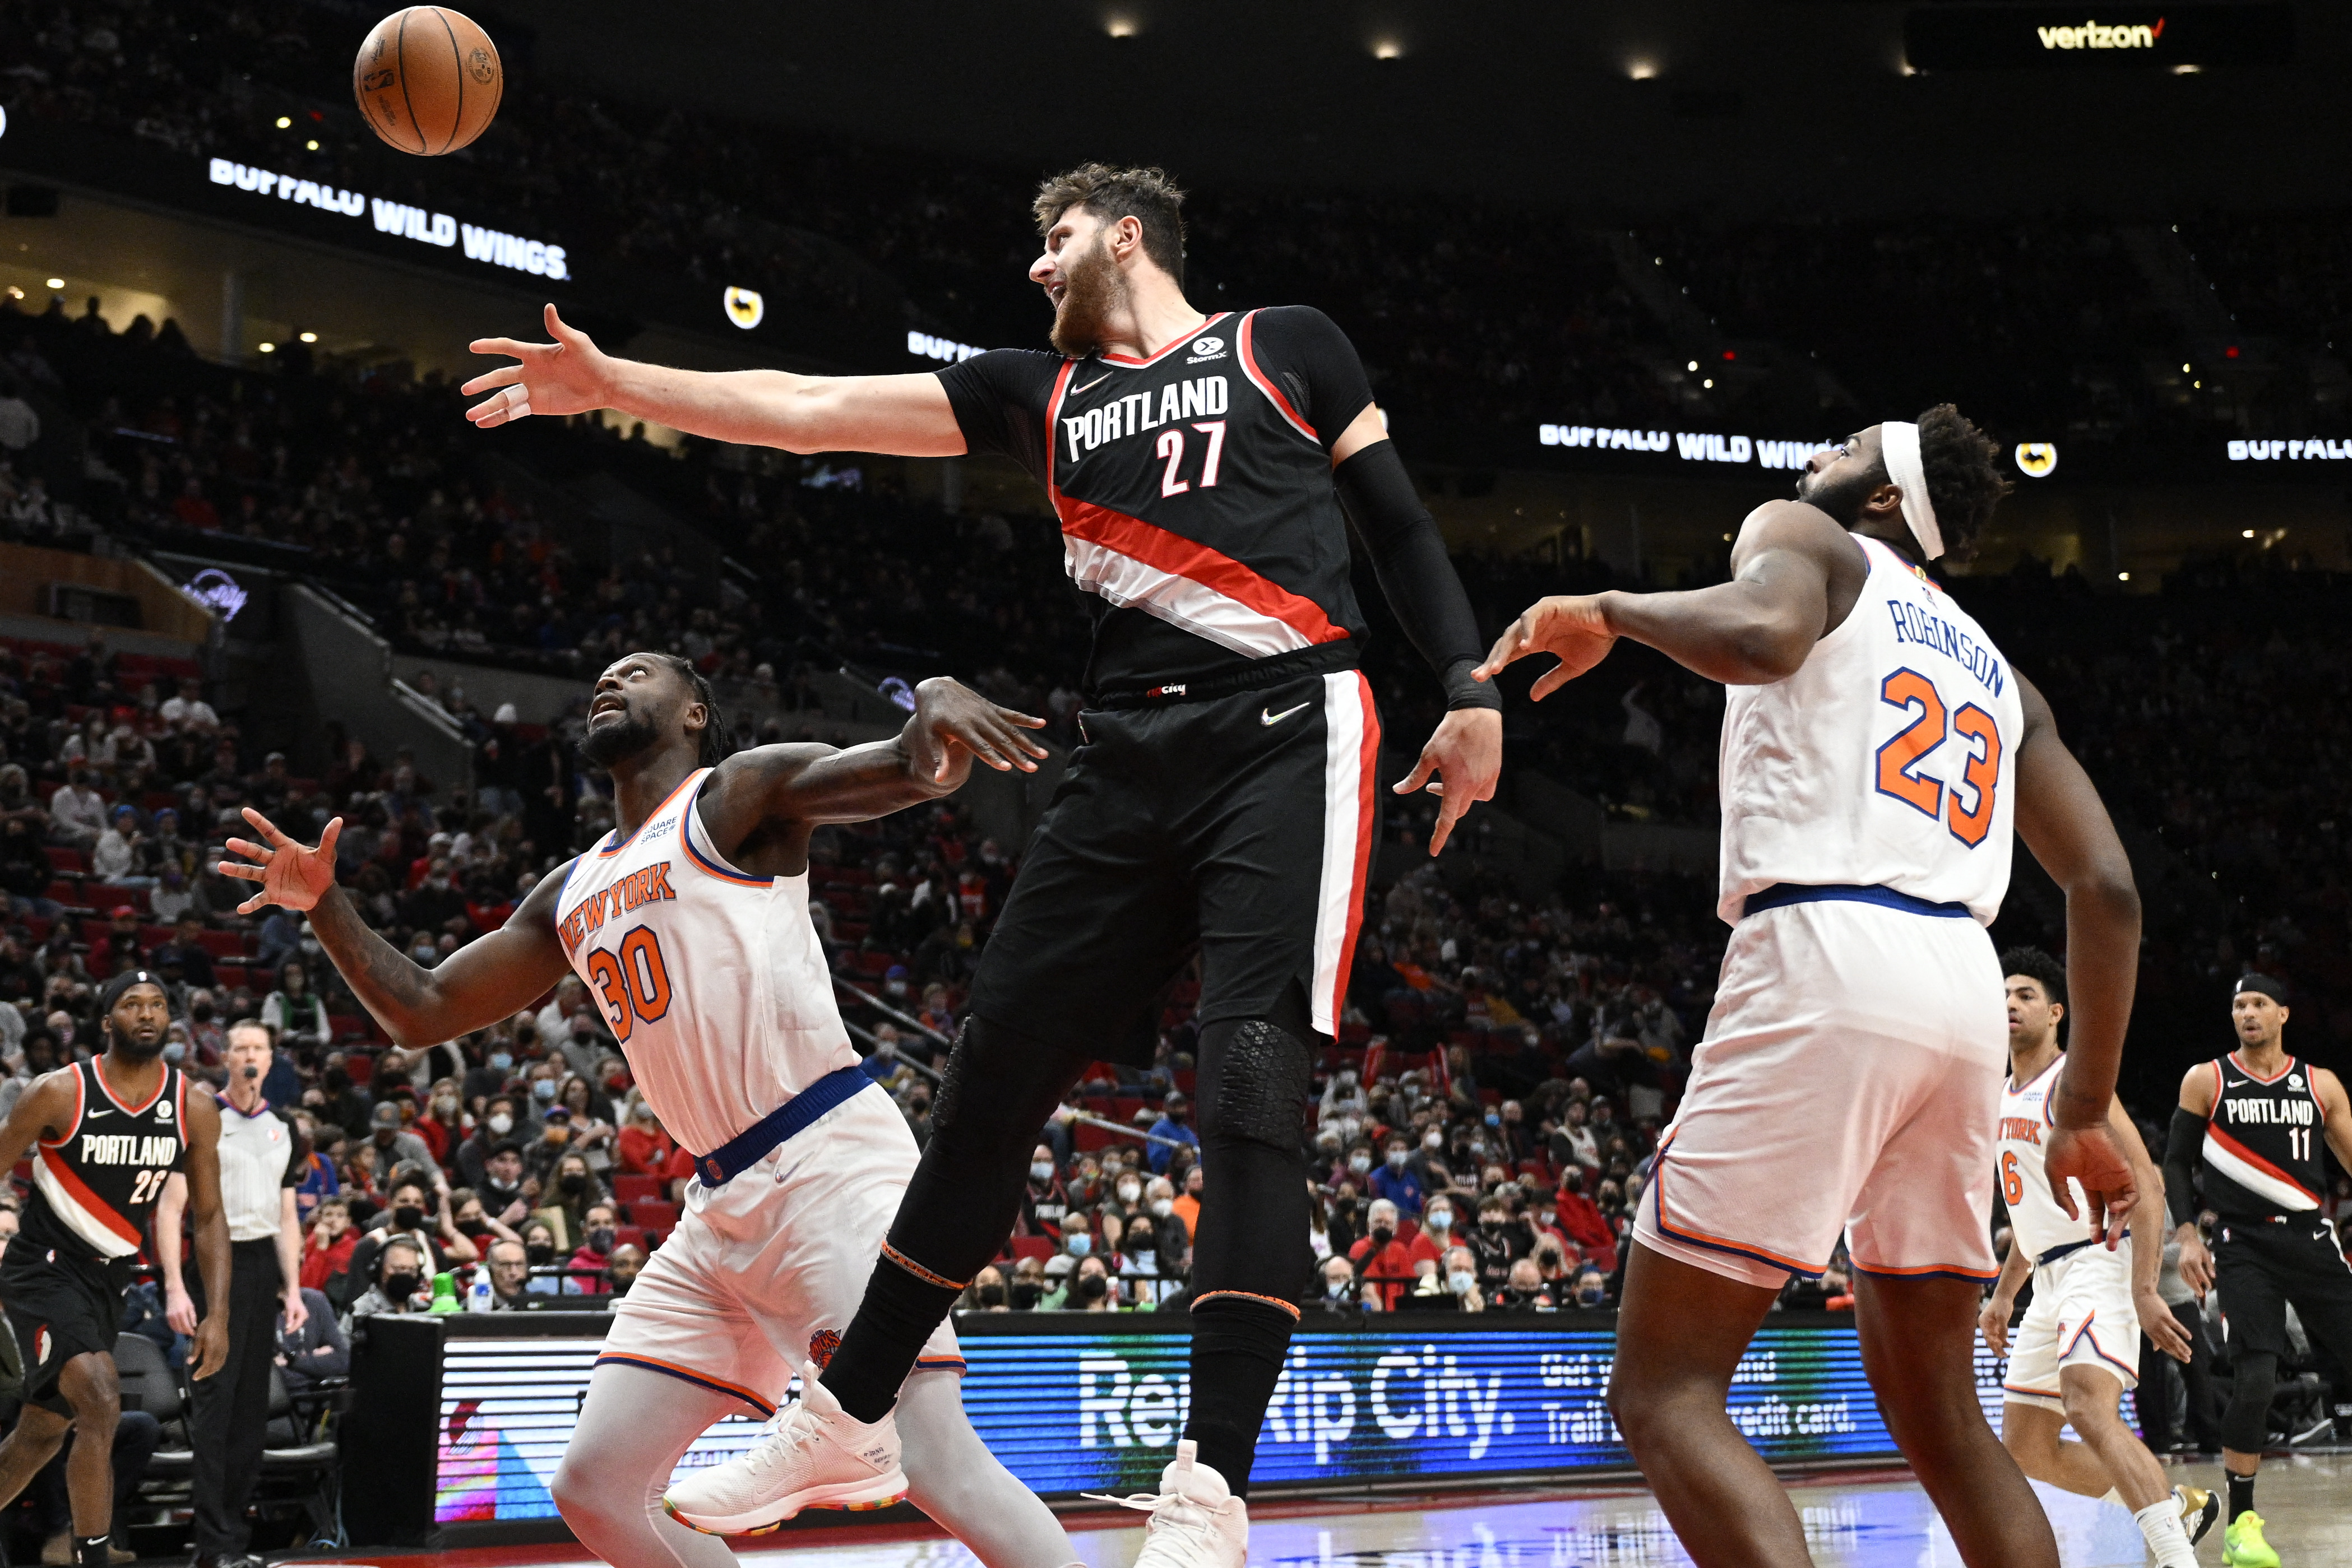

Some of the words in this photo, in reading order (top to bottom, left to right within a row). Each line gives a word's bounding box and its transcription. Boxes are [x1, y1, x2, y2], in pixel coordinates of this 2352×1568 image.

[2038, 20, 2153, 49] verizon
[372, 197, 456, 247] WILD
[461, 223, 567, 280] WINGS
[1187, 351, 1227, 364] StormX
[1061, 376, 1228, 462] PORTLAND
[1156, 420, 1226, 498] 27
[1677, 433, 1752, 463] WILD
[1756, 439, 1844, 470] WIN
[1887, 600, 2003, 699] ROBINSON
[1875, 666, 2002, 850] 23
[641, 827, 668, 845] SPACE
[559, 890, 609, 963] NEW
[609, 860, 678, 921] YORK
[587, 924, 673, 1044] 30
[2005, 1117, 2040, 1145] YORK
[2224, 1098, 2313, 1125] PORTLAND
[81, 1134, 177, 1166] PORTLAND
[2289, 1127, 2310, 1161] 11
[2002, 1151, 2023, 1206] 6
[1371, 1344, 1515, 1460] City.
[1541, 1400, 1603, 1444] Trail
[1726, 1394, 1791, 1436] redit
[1795, 1393, 1856, 1434] card.
